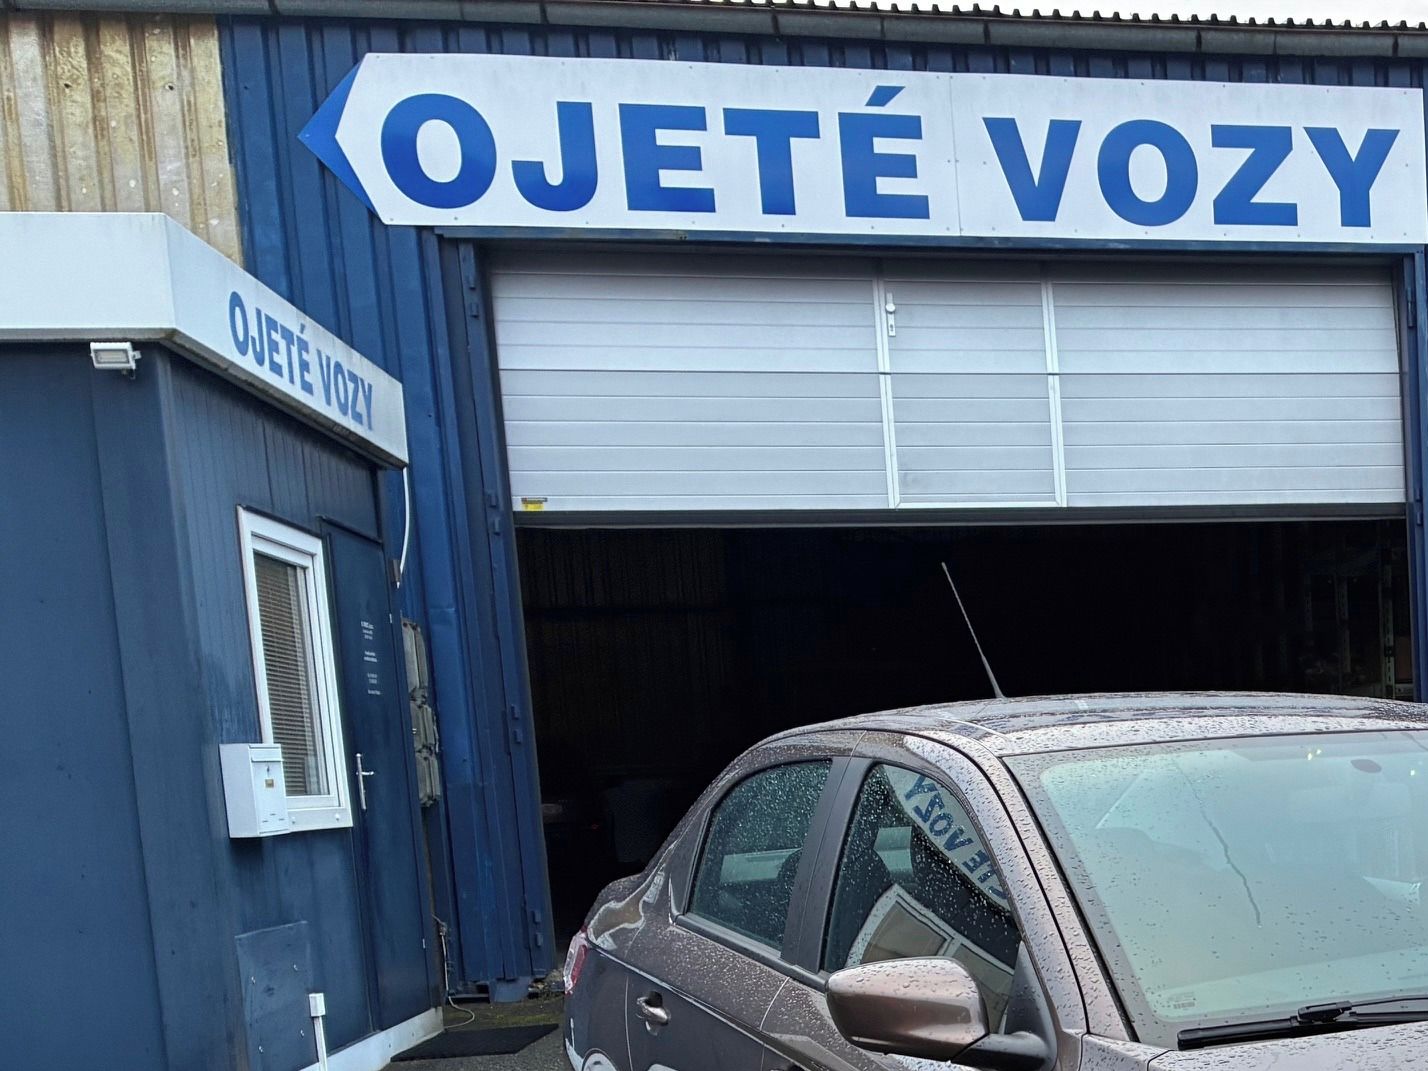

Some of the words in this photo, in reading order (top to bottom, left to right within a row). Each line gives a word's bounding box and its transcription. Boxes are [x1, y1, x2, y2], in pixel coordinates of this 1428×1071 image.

[380, 84, 930, 220] OJETÉ
[984, 117, 1399, 228] VOZY
[229, 290, 315, 396] OJETÉ
[316, 348, 373, 432] VOZY
